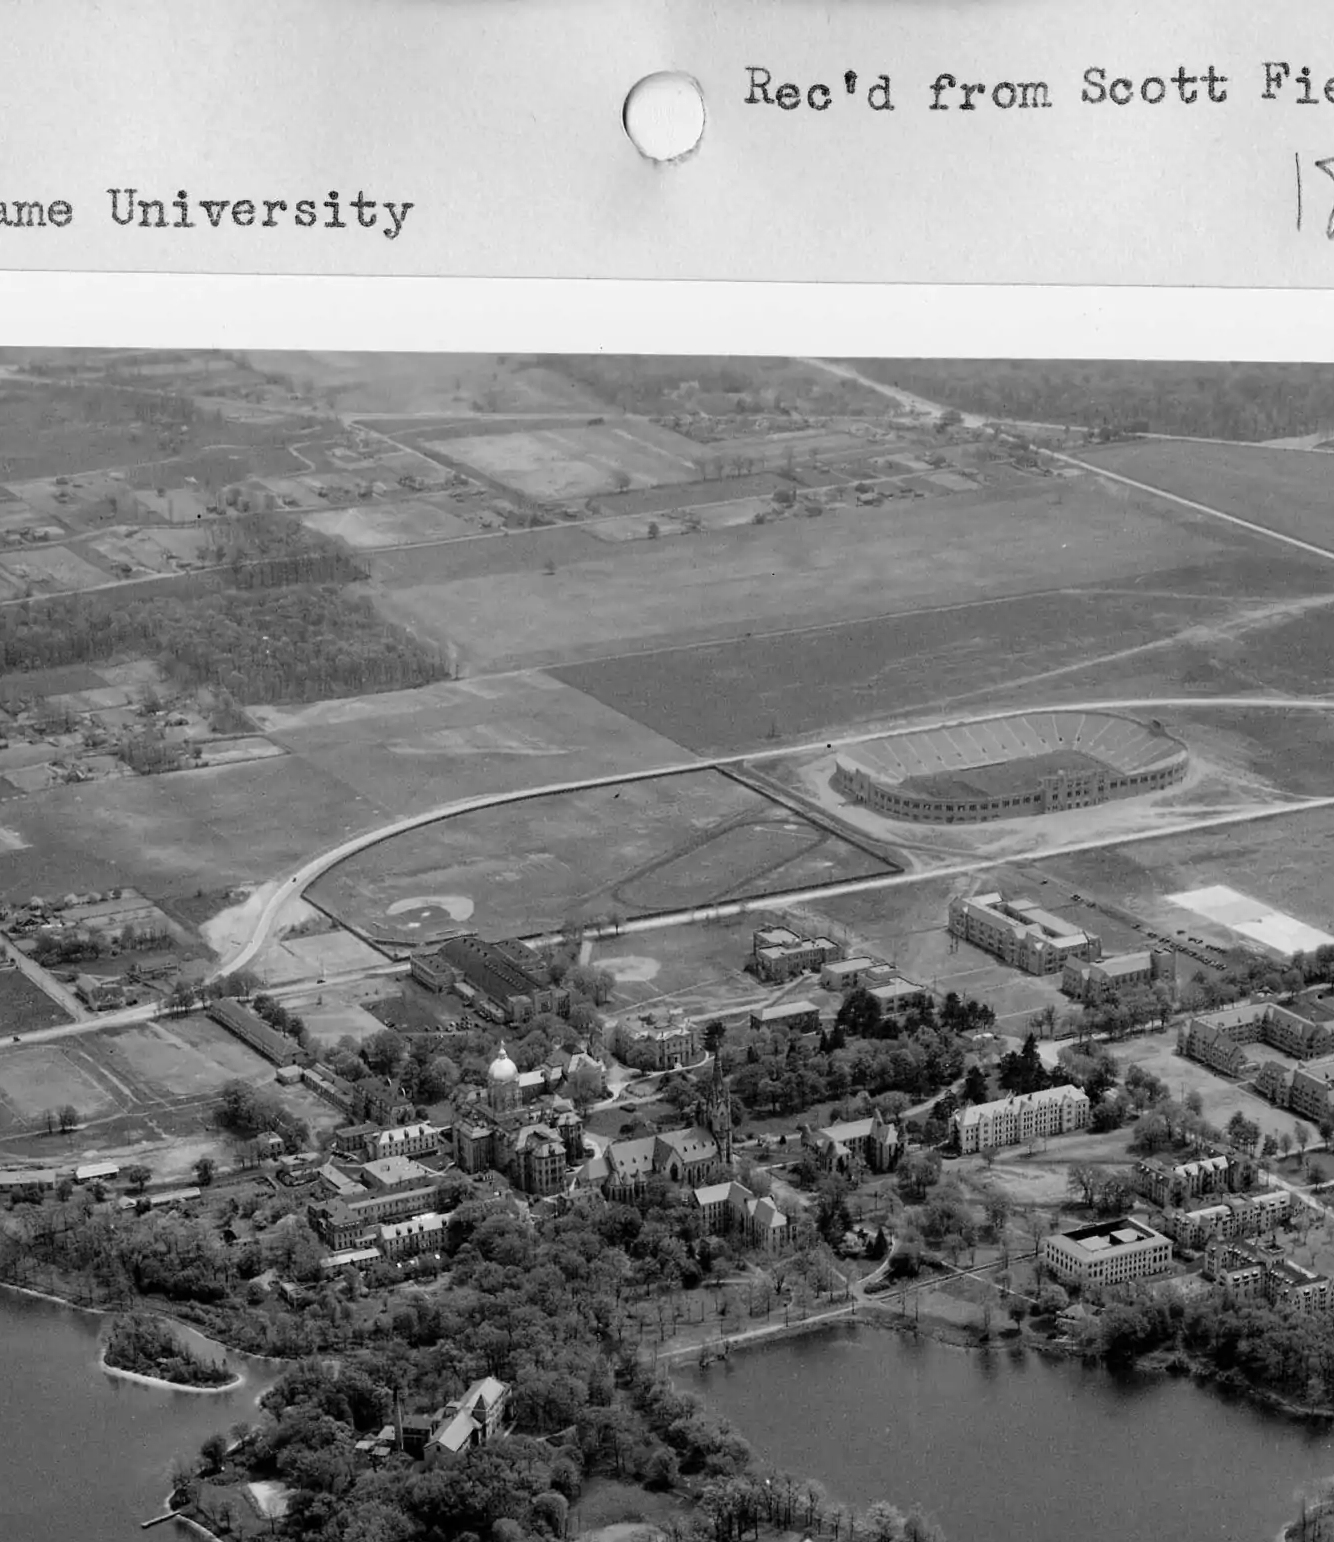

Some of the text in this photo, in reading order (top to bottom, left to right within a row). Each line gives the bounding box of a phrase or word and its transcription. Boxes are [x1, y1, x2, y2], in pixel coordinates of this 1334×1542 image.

[744, 66, 896, 111] Rec'd
[928, 72, 1053, 111] from
[1081, 65, 1229, 106] Scott
[105, 188, 415, 241] University
